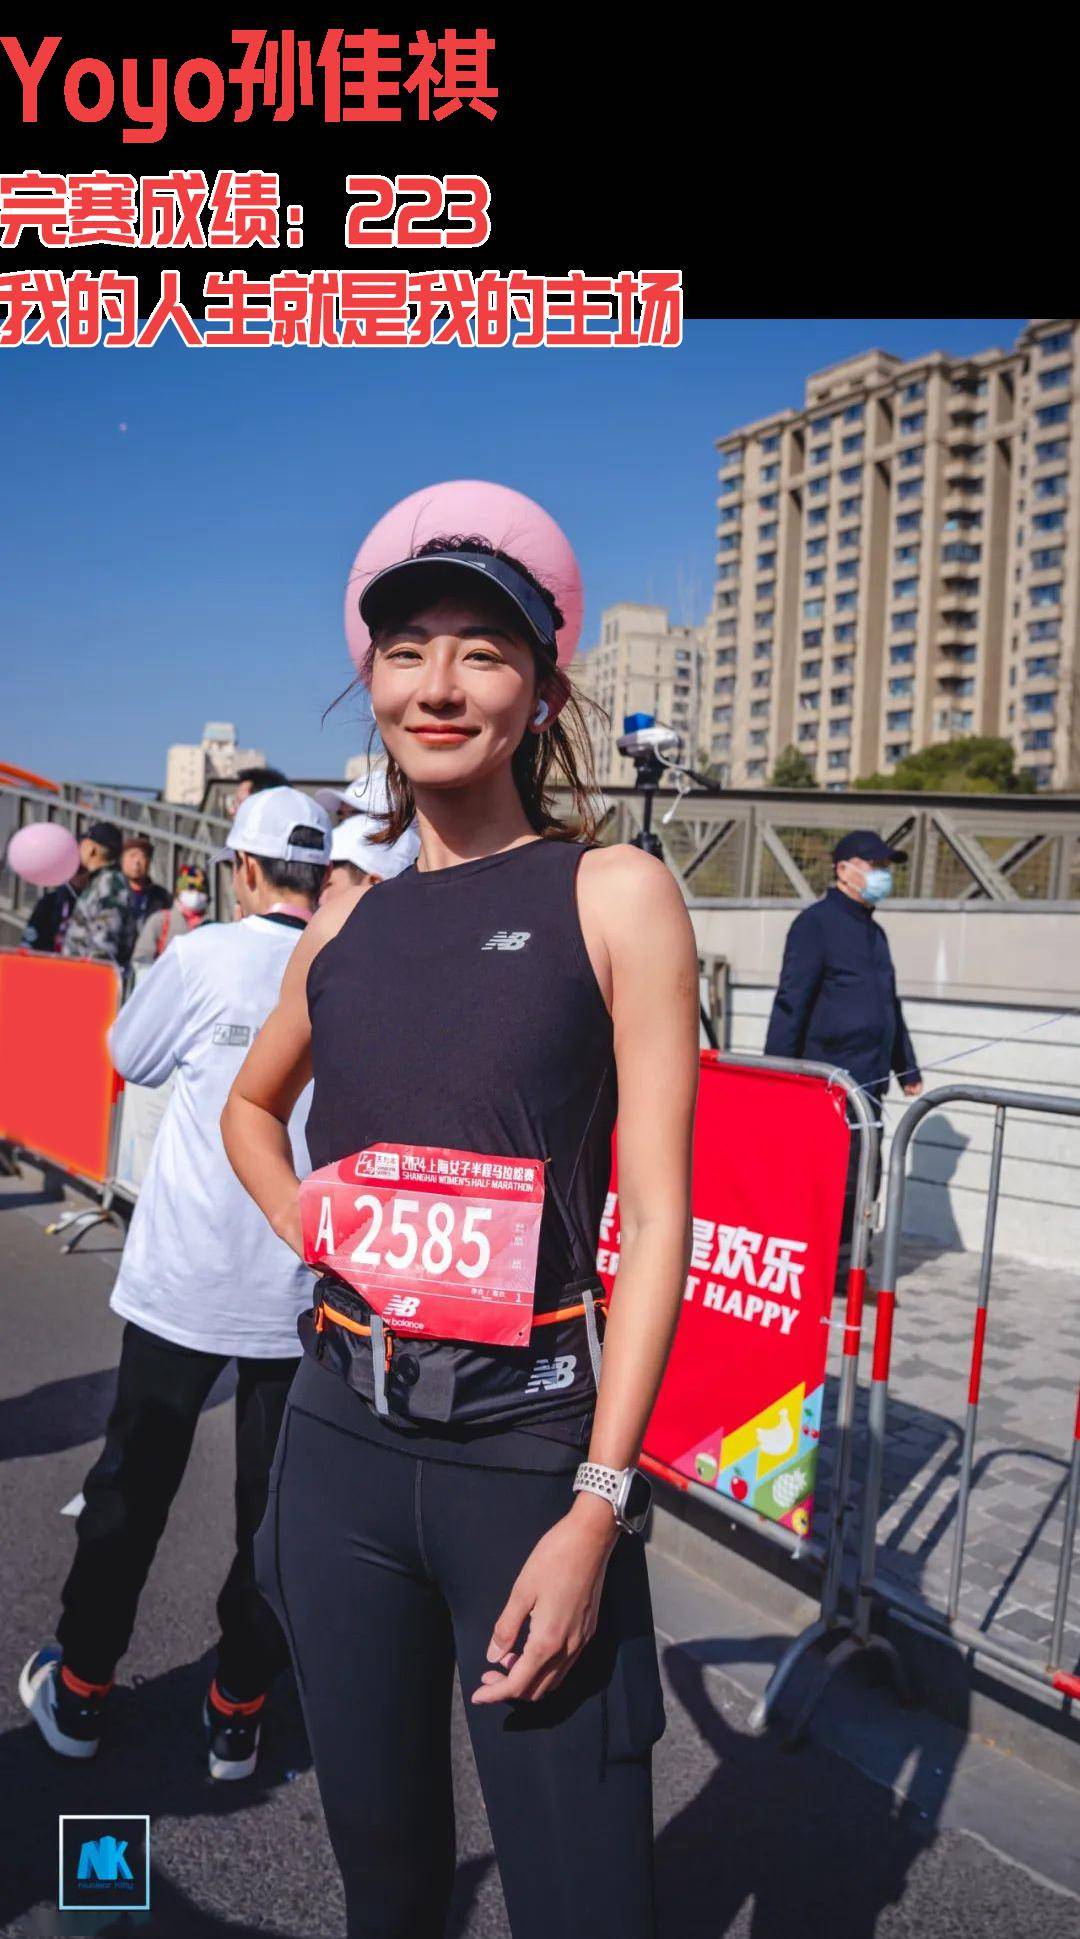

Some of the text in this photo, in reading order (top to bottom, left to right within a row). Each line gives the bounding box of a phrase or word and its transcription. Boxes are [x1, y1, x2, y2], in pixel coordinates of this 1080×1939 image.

[402, 1171, 437, 1184] SHANGHAI
[471, 1178, 490, 1188] HALF
[491, 1180, 534, 1192] MARATHON
[314, 1194, 492, 1279] A 2585
[702, 1280, 800, 1336] HAPPY
